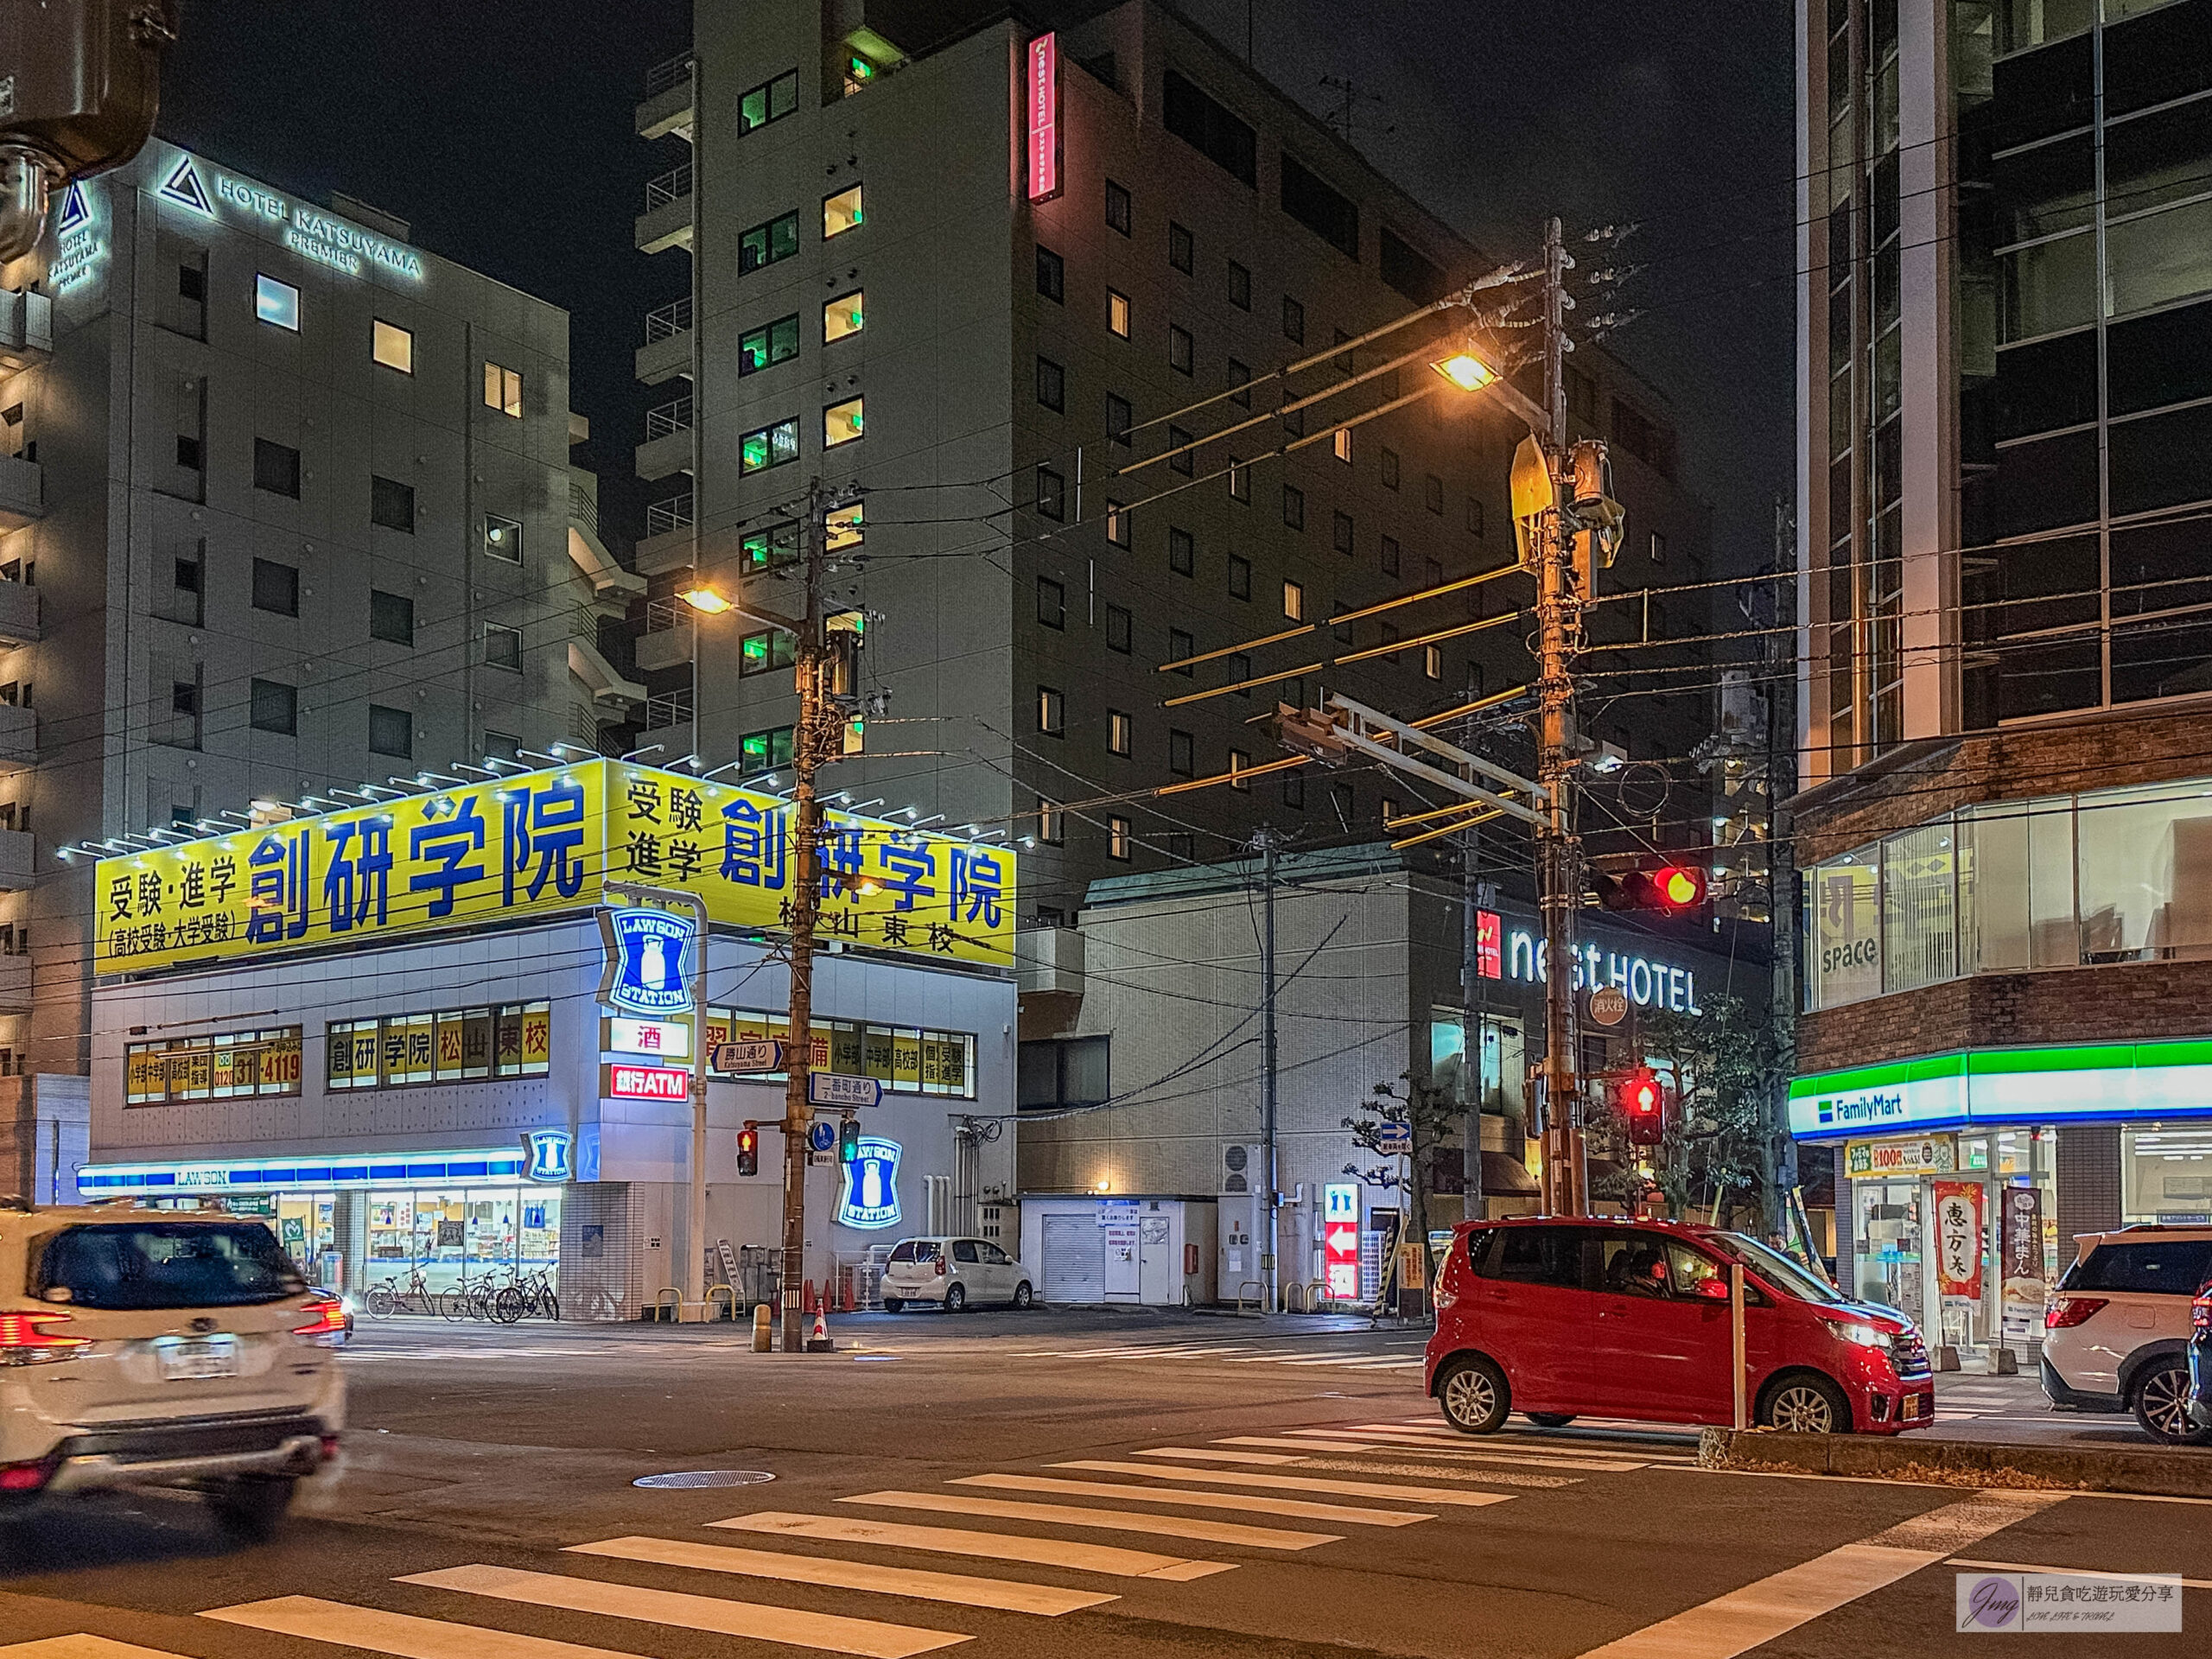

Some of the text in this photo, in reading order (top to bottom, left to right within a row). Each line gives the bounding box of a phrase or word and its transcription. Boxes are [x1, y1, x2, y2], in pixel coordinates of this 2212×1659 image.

[219, 179, 421, 276] HOTEL KATSUYAMA
[60, 230, 88, 254] HOTEL
[289, 231, 359, 270] PREMIER
[48, 241, 99, 278] KATSUYAMA
[627, 778, 703, 833] 受験
[245, 779, 585, 945] 創研学院
[626, 830, 702, 883] 進学
[719, 798, 1002, 930] 創研学院
[621, 917, 686, 942] LAWSON
[1823, 938, 1876, 973] space
[620, 984, 685, 1006] STATION
[1610, 951, 1703, 1017] HOTEL
[1594, 997, 1625, 1014] 消火栓
[333, 1020, 547, 1072] 創研学院 松山東校
[638, 1025, 662, 1049] 酒
[725, 1044, 767, 1061] 勝山通り
[834, 1043, 860, 1065] 小学部
[867, 1046, 891, 1069] 中学部
[894, 1047, 918, 1071] 高校部
[942, 1046, 962, 1065] 受験
[615, 1069, 683, 1096] 銀行ATM
[942, 1064, 962, 1082] 進学
[822, 1077, 871, 1095] 二番町通り
[852, 1093, 869, 1103] Street
[1837, 1092, 1903, 1122] FamilyMart
[856, 1145, 896, 1163] AWSON
[178, 1170, 226, 1185] LAWSON
[537, 1166, 568, 1176] STATION
[848, 1203, 896, 1221] STATION
[1944, 1202, 1967, 1277] 恵方巻
[2013, 1211, 2031, 1275] 中華まん
